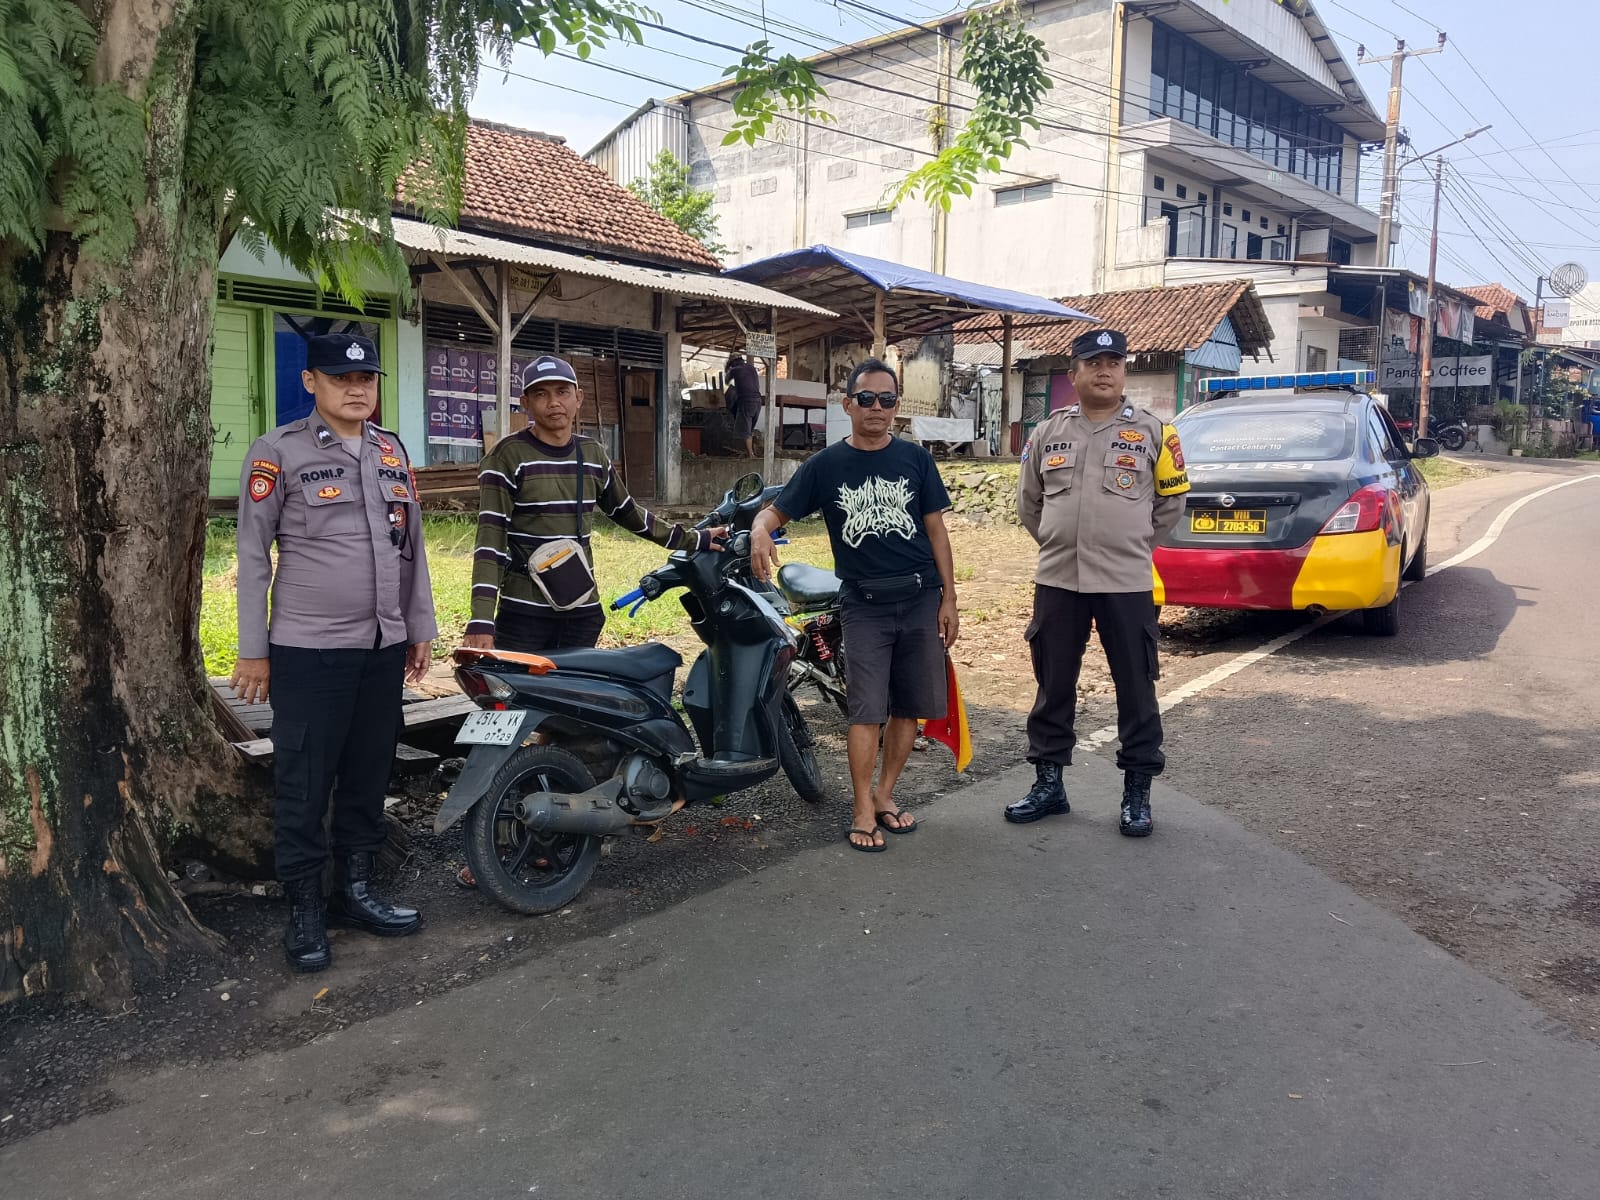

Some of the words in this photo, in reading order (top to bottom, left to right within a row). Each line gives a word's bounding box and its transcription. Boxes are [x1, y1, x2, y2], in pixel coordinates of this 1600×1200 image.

[1386, 367, 1435, 378] Panaa
[1439, 364, 1487, 377] Coffee
[1045, 443, 1072, 453] DEDI
[1110, 441, 1147, 454] POLRI
[1210, 444, 1240, 452] Contact
[1185, 463, 1315, 471] OLISI
[300, 467, 345, 483] RONI.P
[378, 468, 408, 483] POLRI
